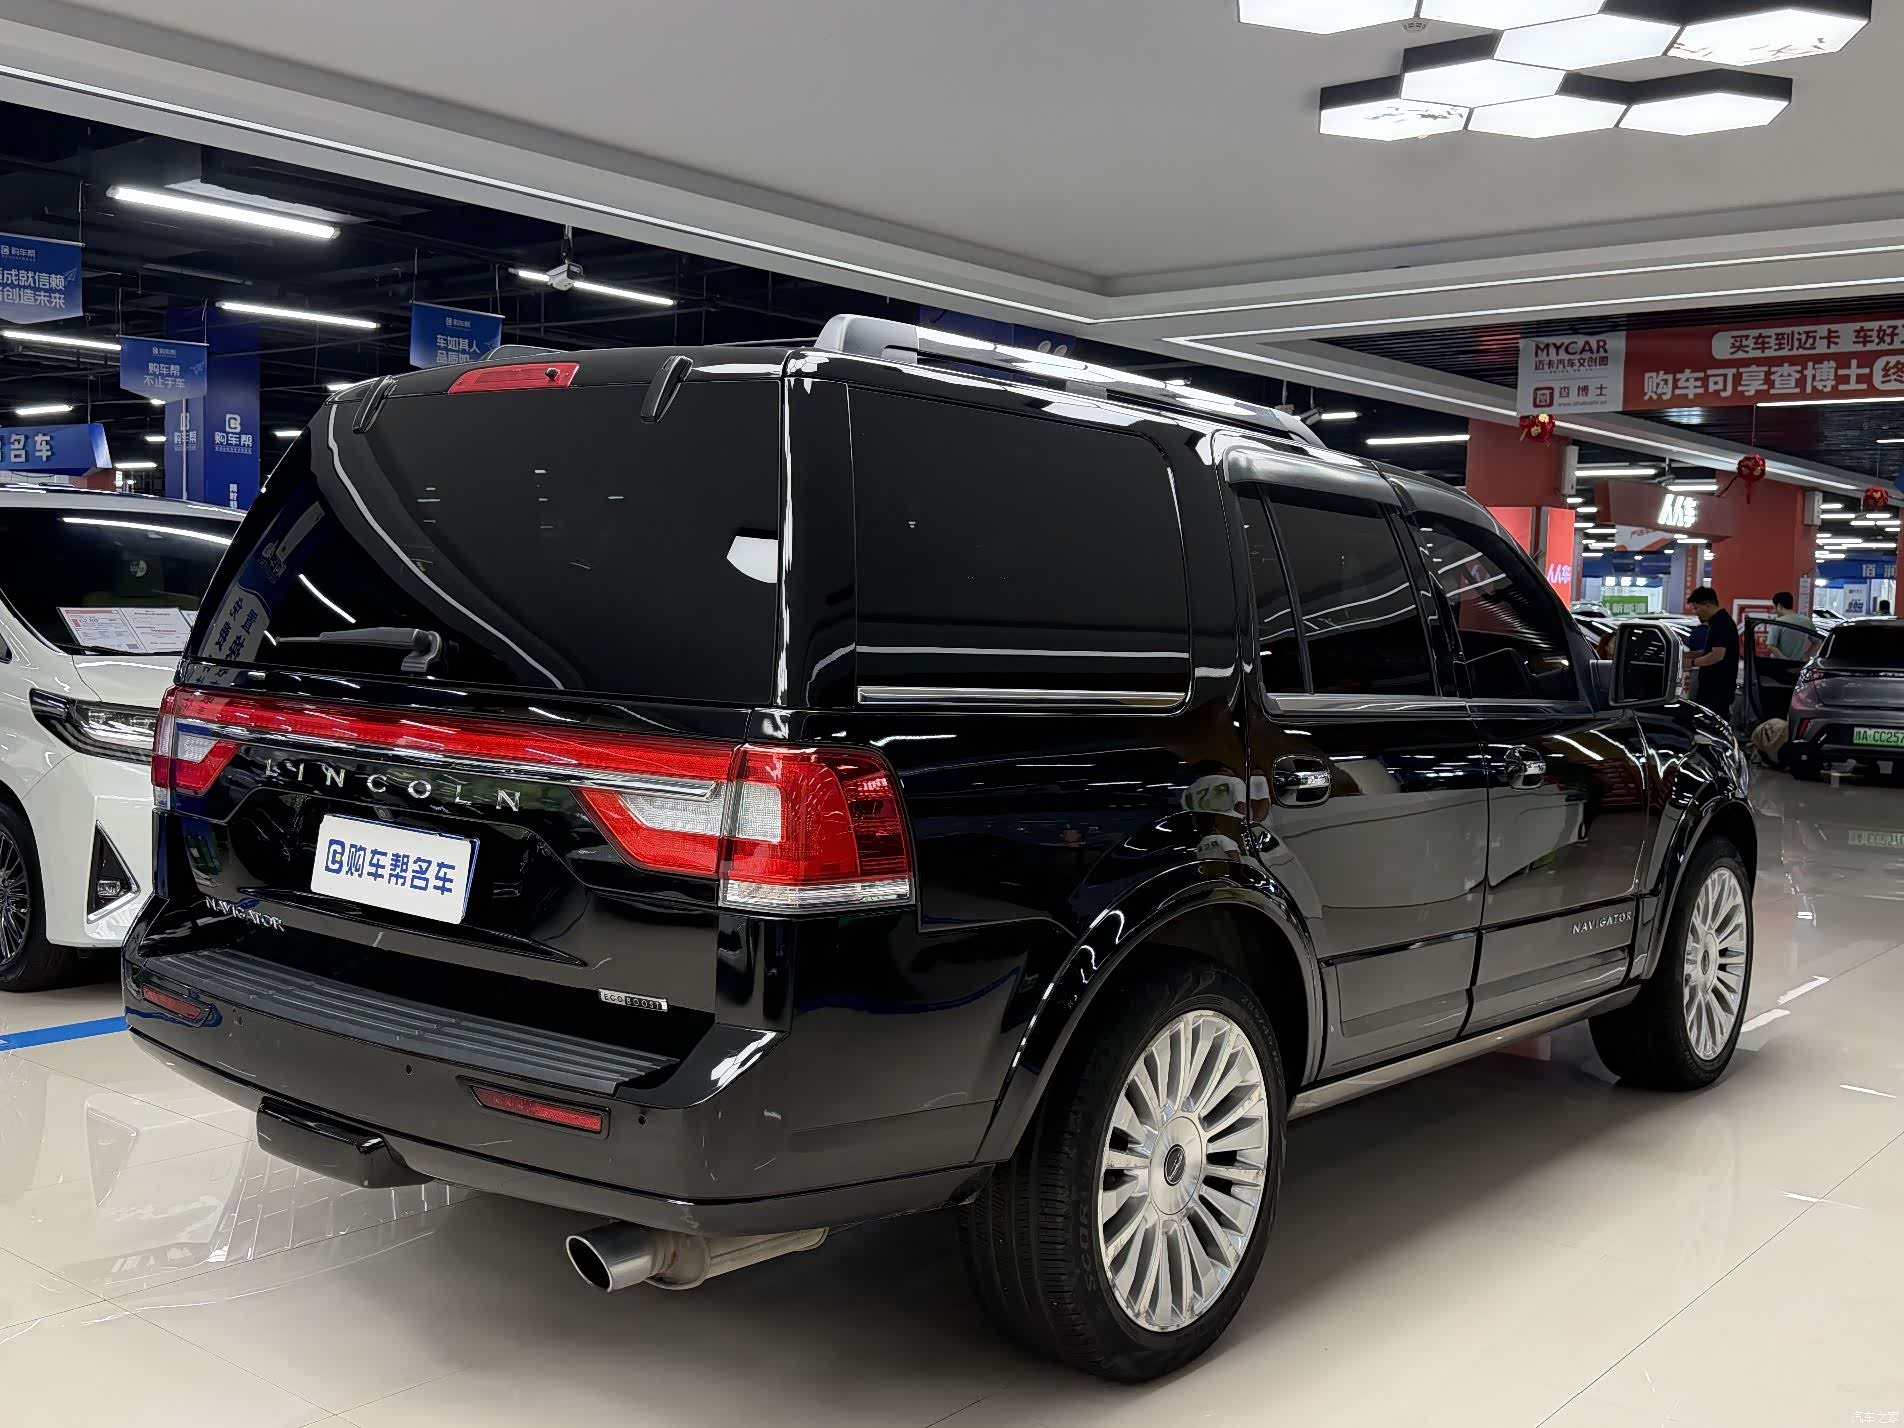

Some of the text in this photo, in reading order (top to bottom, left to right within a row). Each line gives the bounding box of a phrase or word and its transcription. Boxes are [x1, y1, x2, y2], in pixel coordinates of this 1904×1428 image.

[0, 268, 65, 291] 成就信赖
[0, 286, 66, 309] 创造未来
[436, 334, 481, 354] 车如其人
[1534, 339, 1609, 358] MYCAR
[1729, 324, 1904, 356] 买车到迈卡 车好
[148, 362, 181, 377] 购车帮
[1643, 358, 1871, 401] 购车可享查博士
[143, 375, 185, 389] 不止于车
[1558, 384, 1609, 398] 查博士
[0, 433, 52, 463] 名车
[214, 431, 253, 448] 购车帮
[264, 758, 521, 812] LINCOLN
[345, 842, 457, 896] 购车帮名车
[205, 896, 285, 931] NAVIGATOR
[1571, 911, 1632, 935] NAVIGATOR
